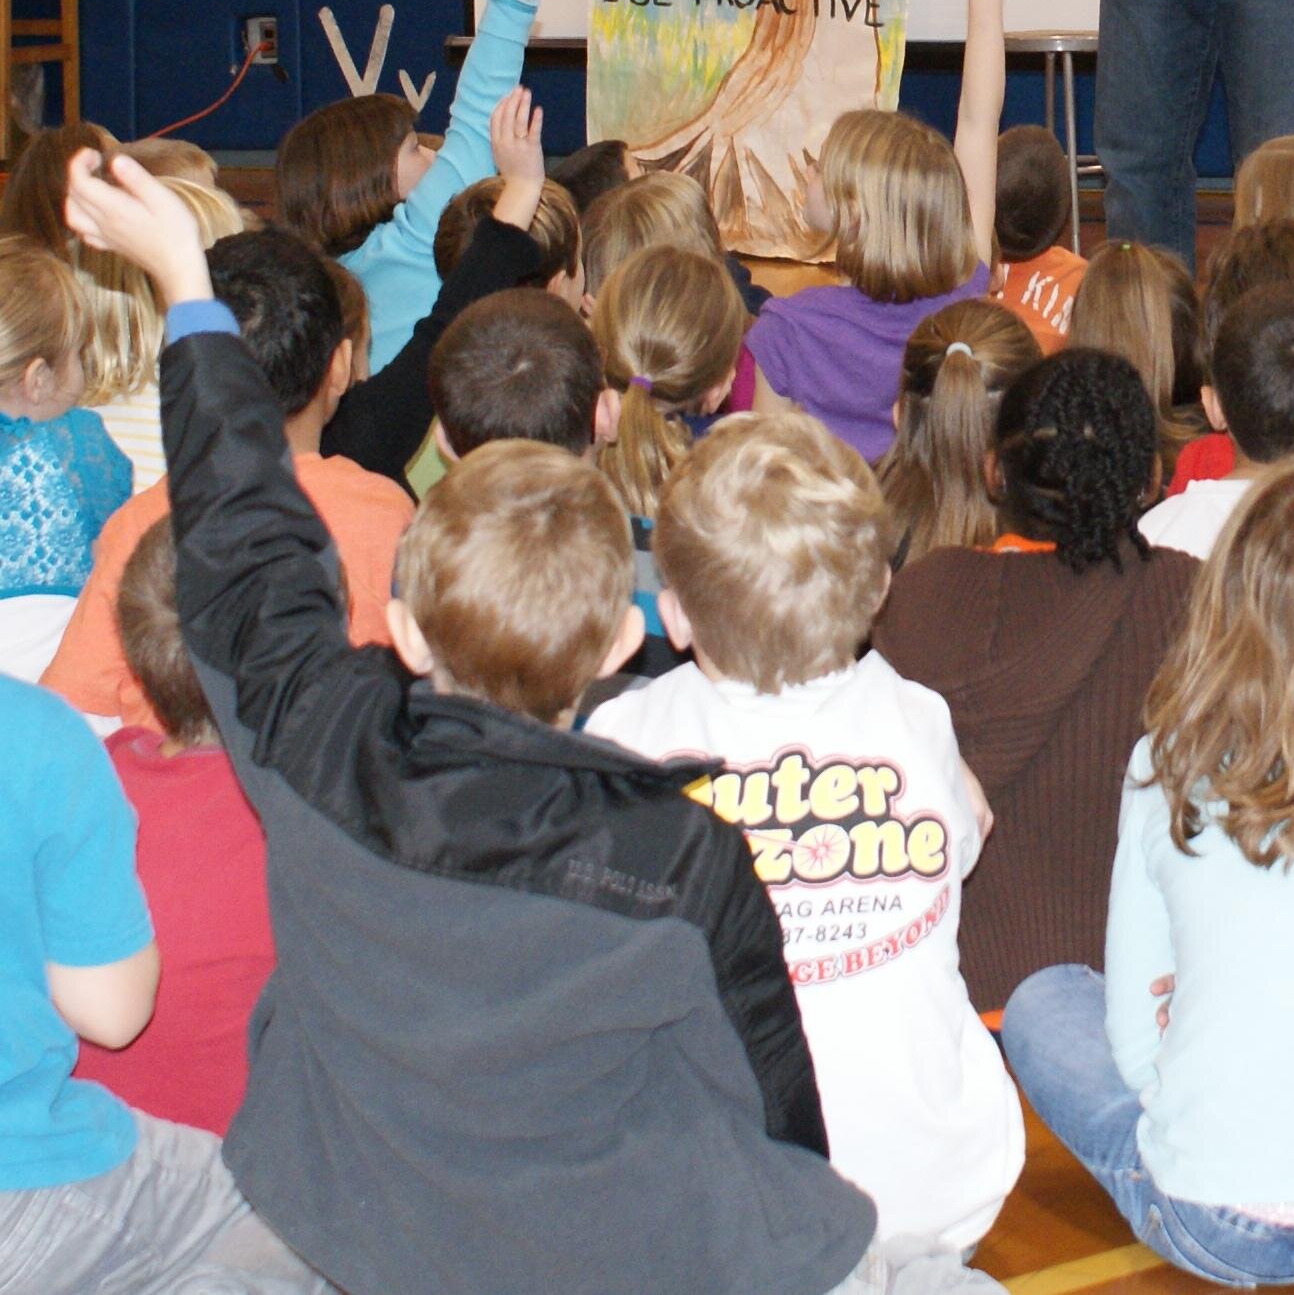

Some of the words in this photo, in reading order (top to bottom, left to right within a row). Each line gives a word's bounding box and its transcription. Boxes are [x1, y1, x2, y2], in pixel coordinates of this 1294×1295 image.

[681, 752, 900, 827] uter
[773, 899, 813, 919] AG
[821, 894, 903, 916] ARENA
